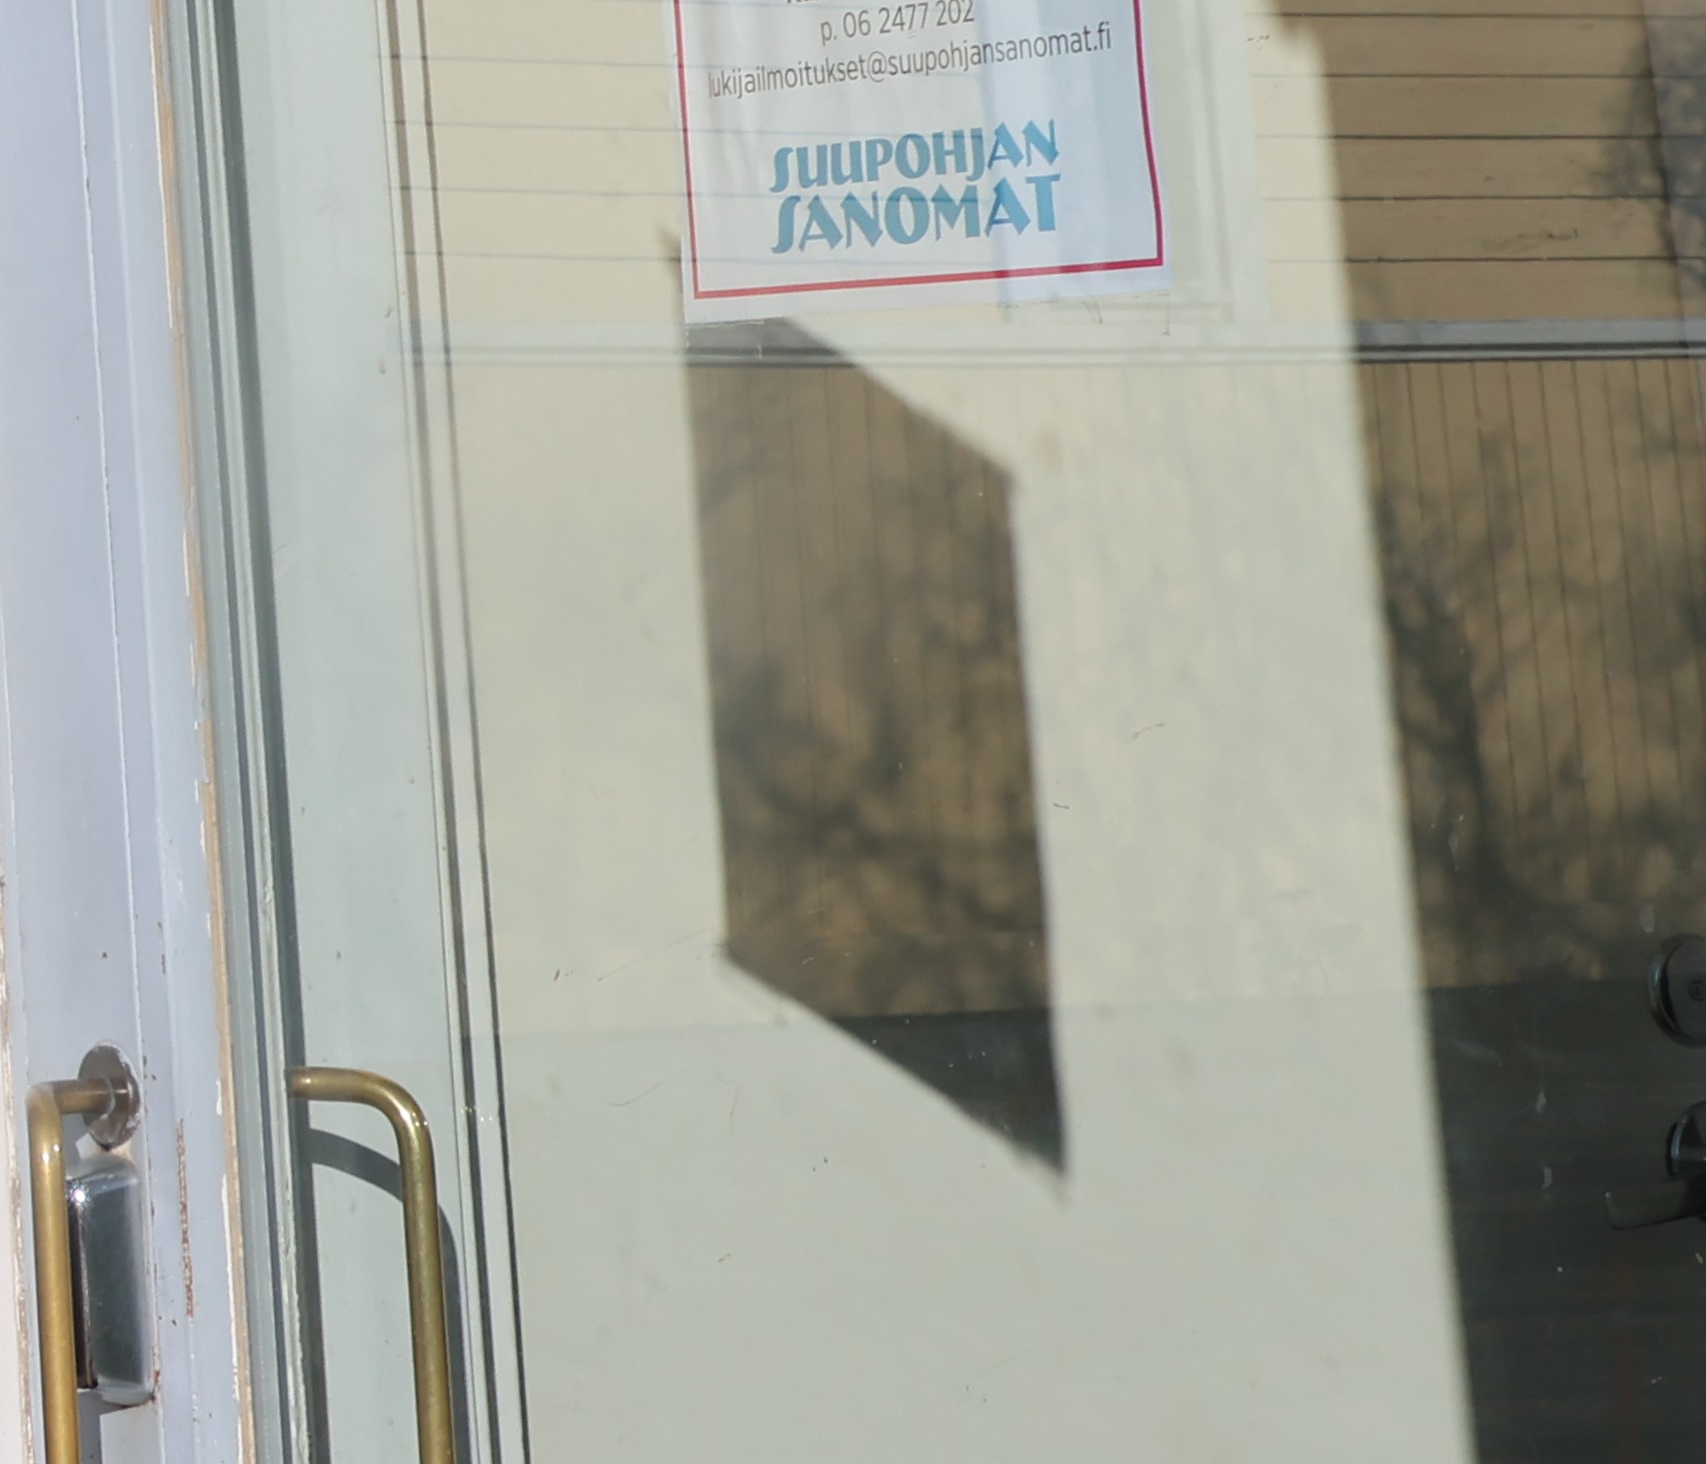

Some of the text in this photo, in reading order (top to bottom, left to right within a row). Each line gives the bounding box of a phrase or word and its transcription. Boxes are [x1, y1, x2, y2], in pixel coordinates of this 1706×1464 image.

[707, 22, 1112, 99] lukijailmoitukset@suupohjansanomat.fi
[820, 19, 838, 46] p.
[842, 11, 871, 39] 06
[878, 1, 928, 34] 2477
[769, 119, 1060, 193] SUUPOHJAN
[770, 174, 1062, 255] SANOMAT
